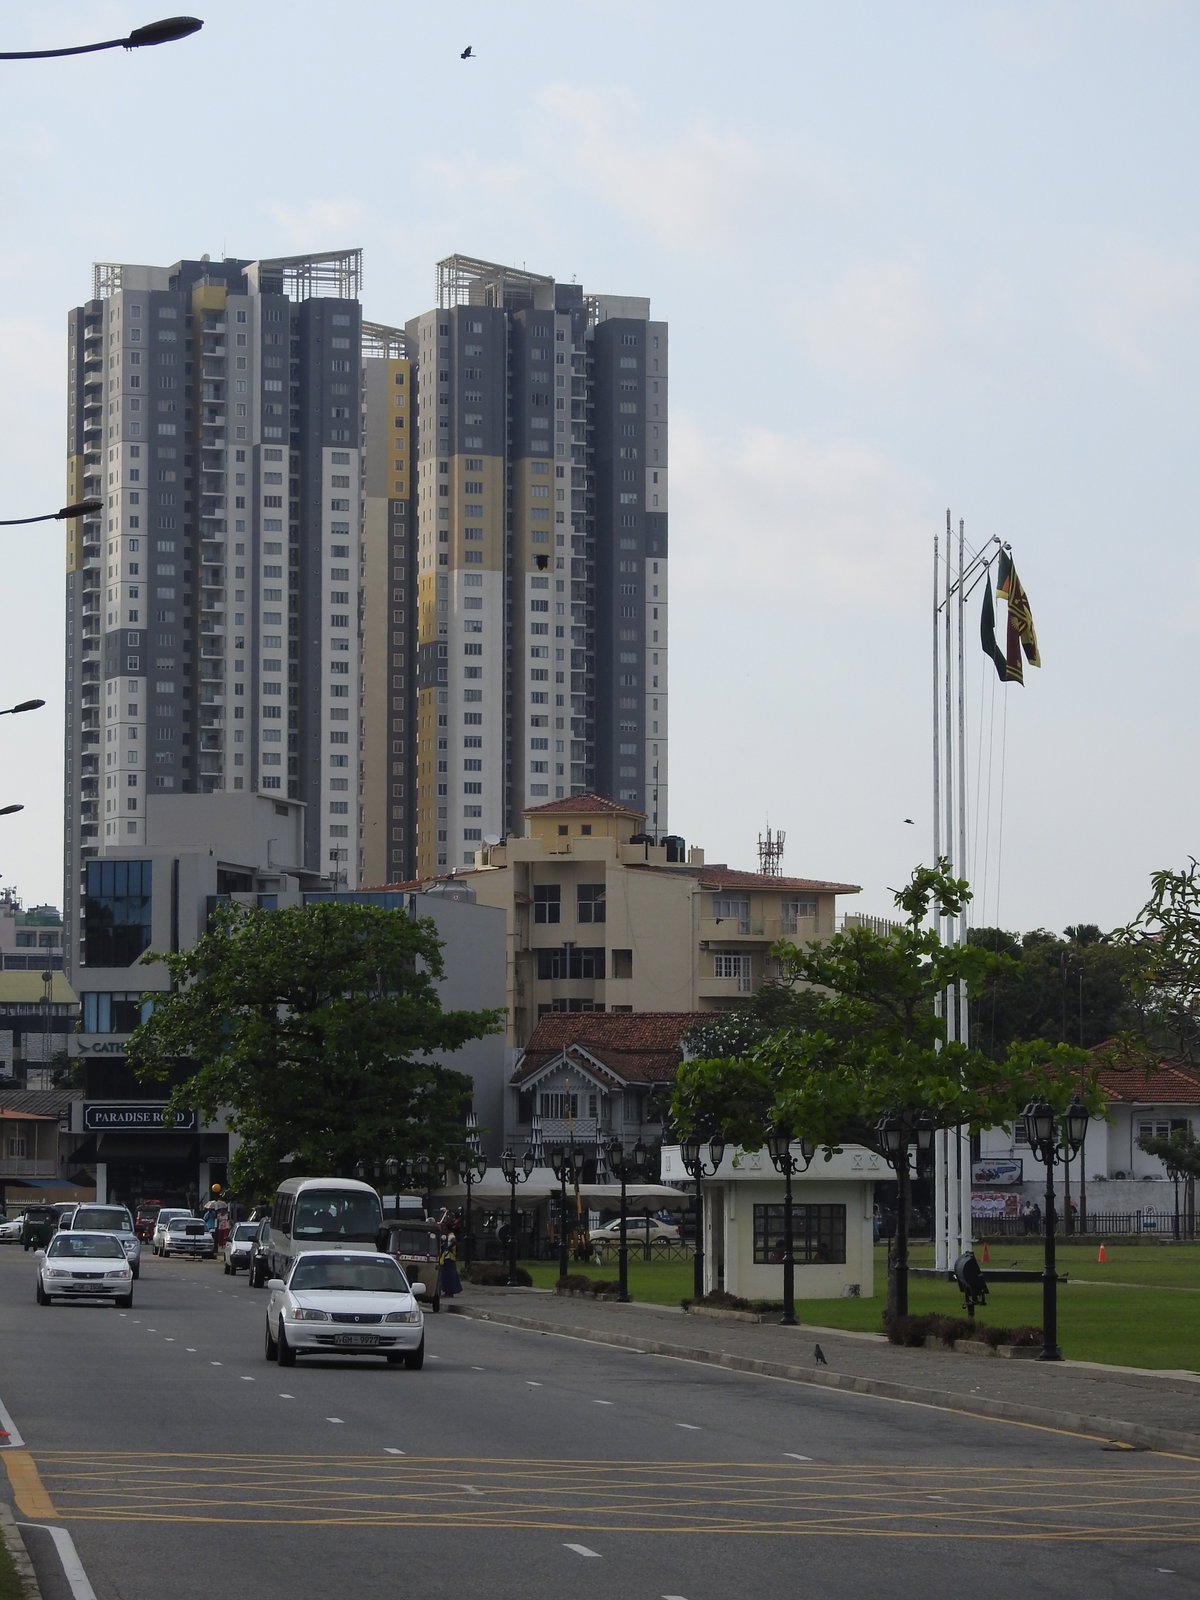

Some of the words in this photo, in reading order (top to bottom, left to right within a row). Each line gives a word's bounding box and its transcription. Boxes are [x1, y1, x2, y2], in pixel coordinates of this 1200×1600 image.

[92, 1042, 126, 1053] CATH
[95, 1112, 151, 1122] PARADISE
[153, 1112, 185, 1122] ROD
